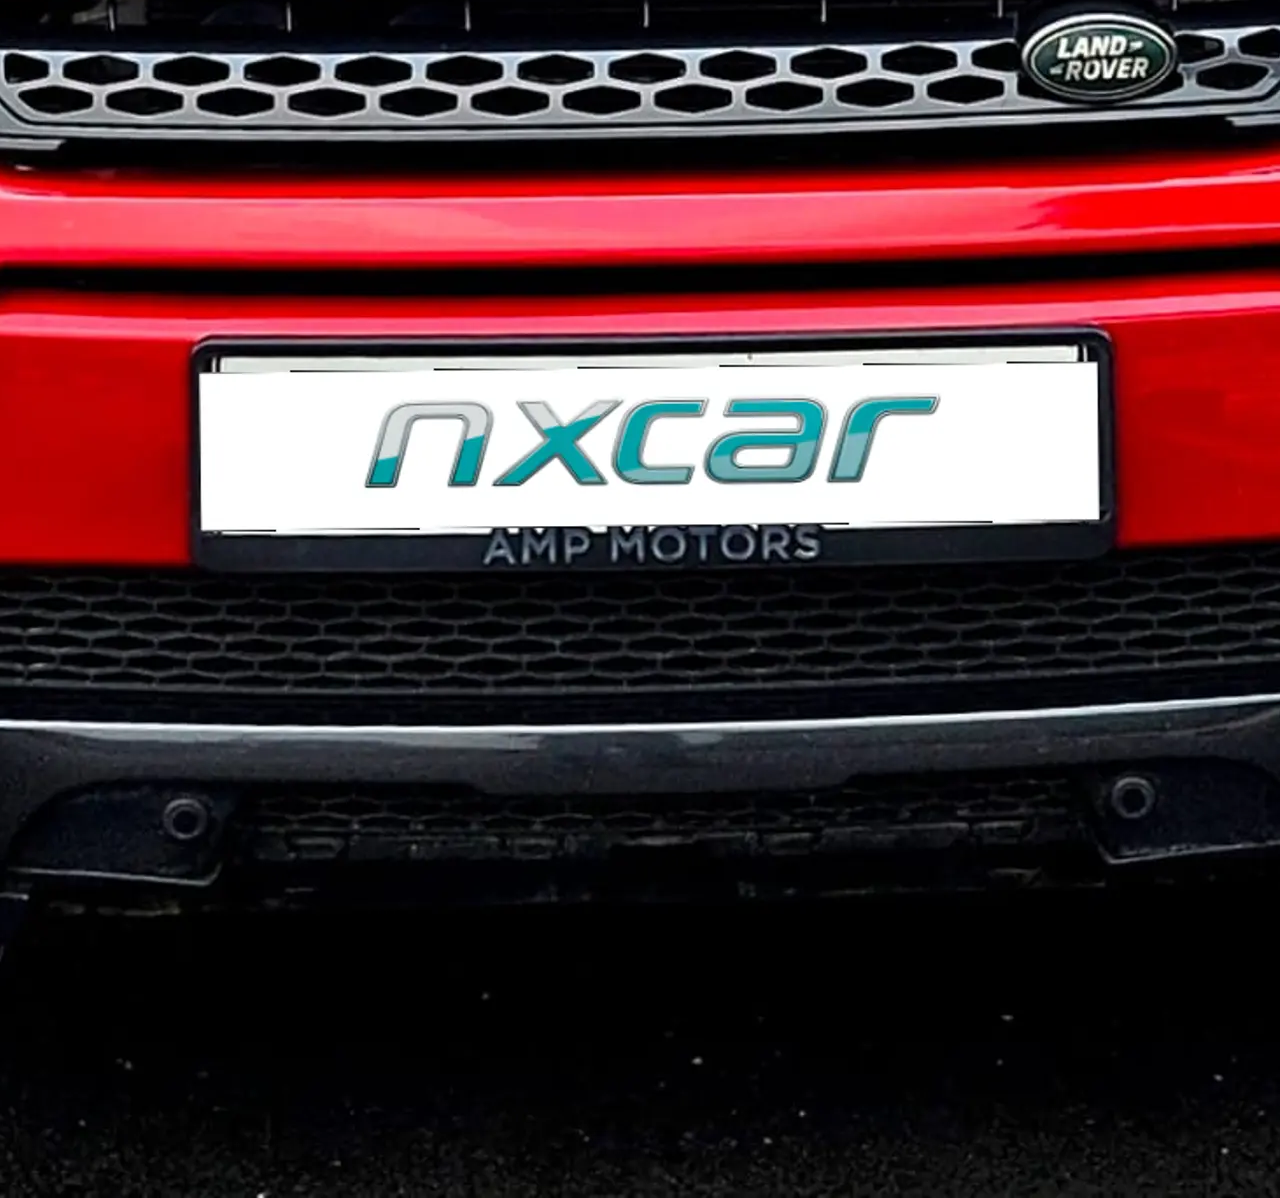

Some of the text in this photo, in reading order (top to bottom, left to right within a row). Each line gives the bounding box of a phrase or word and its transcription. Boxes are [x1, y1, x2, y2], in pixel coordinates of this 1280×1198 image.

[1057, 35, 1126, 59] LAND
[1065, 56, 1149, 81] ROVER
[483, 524, 822, 565] AMP MOTORS
